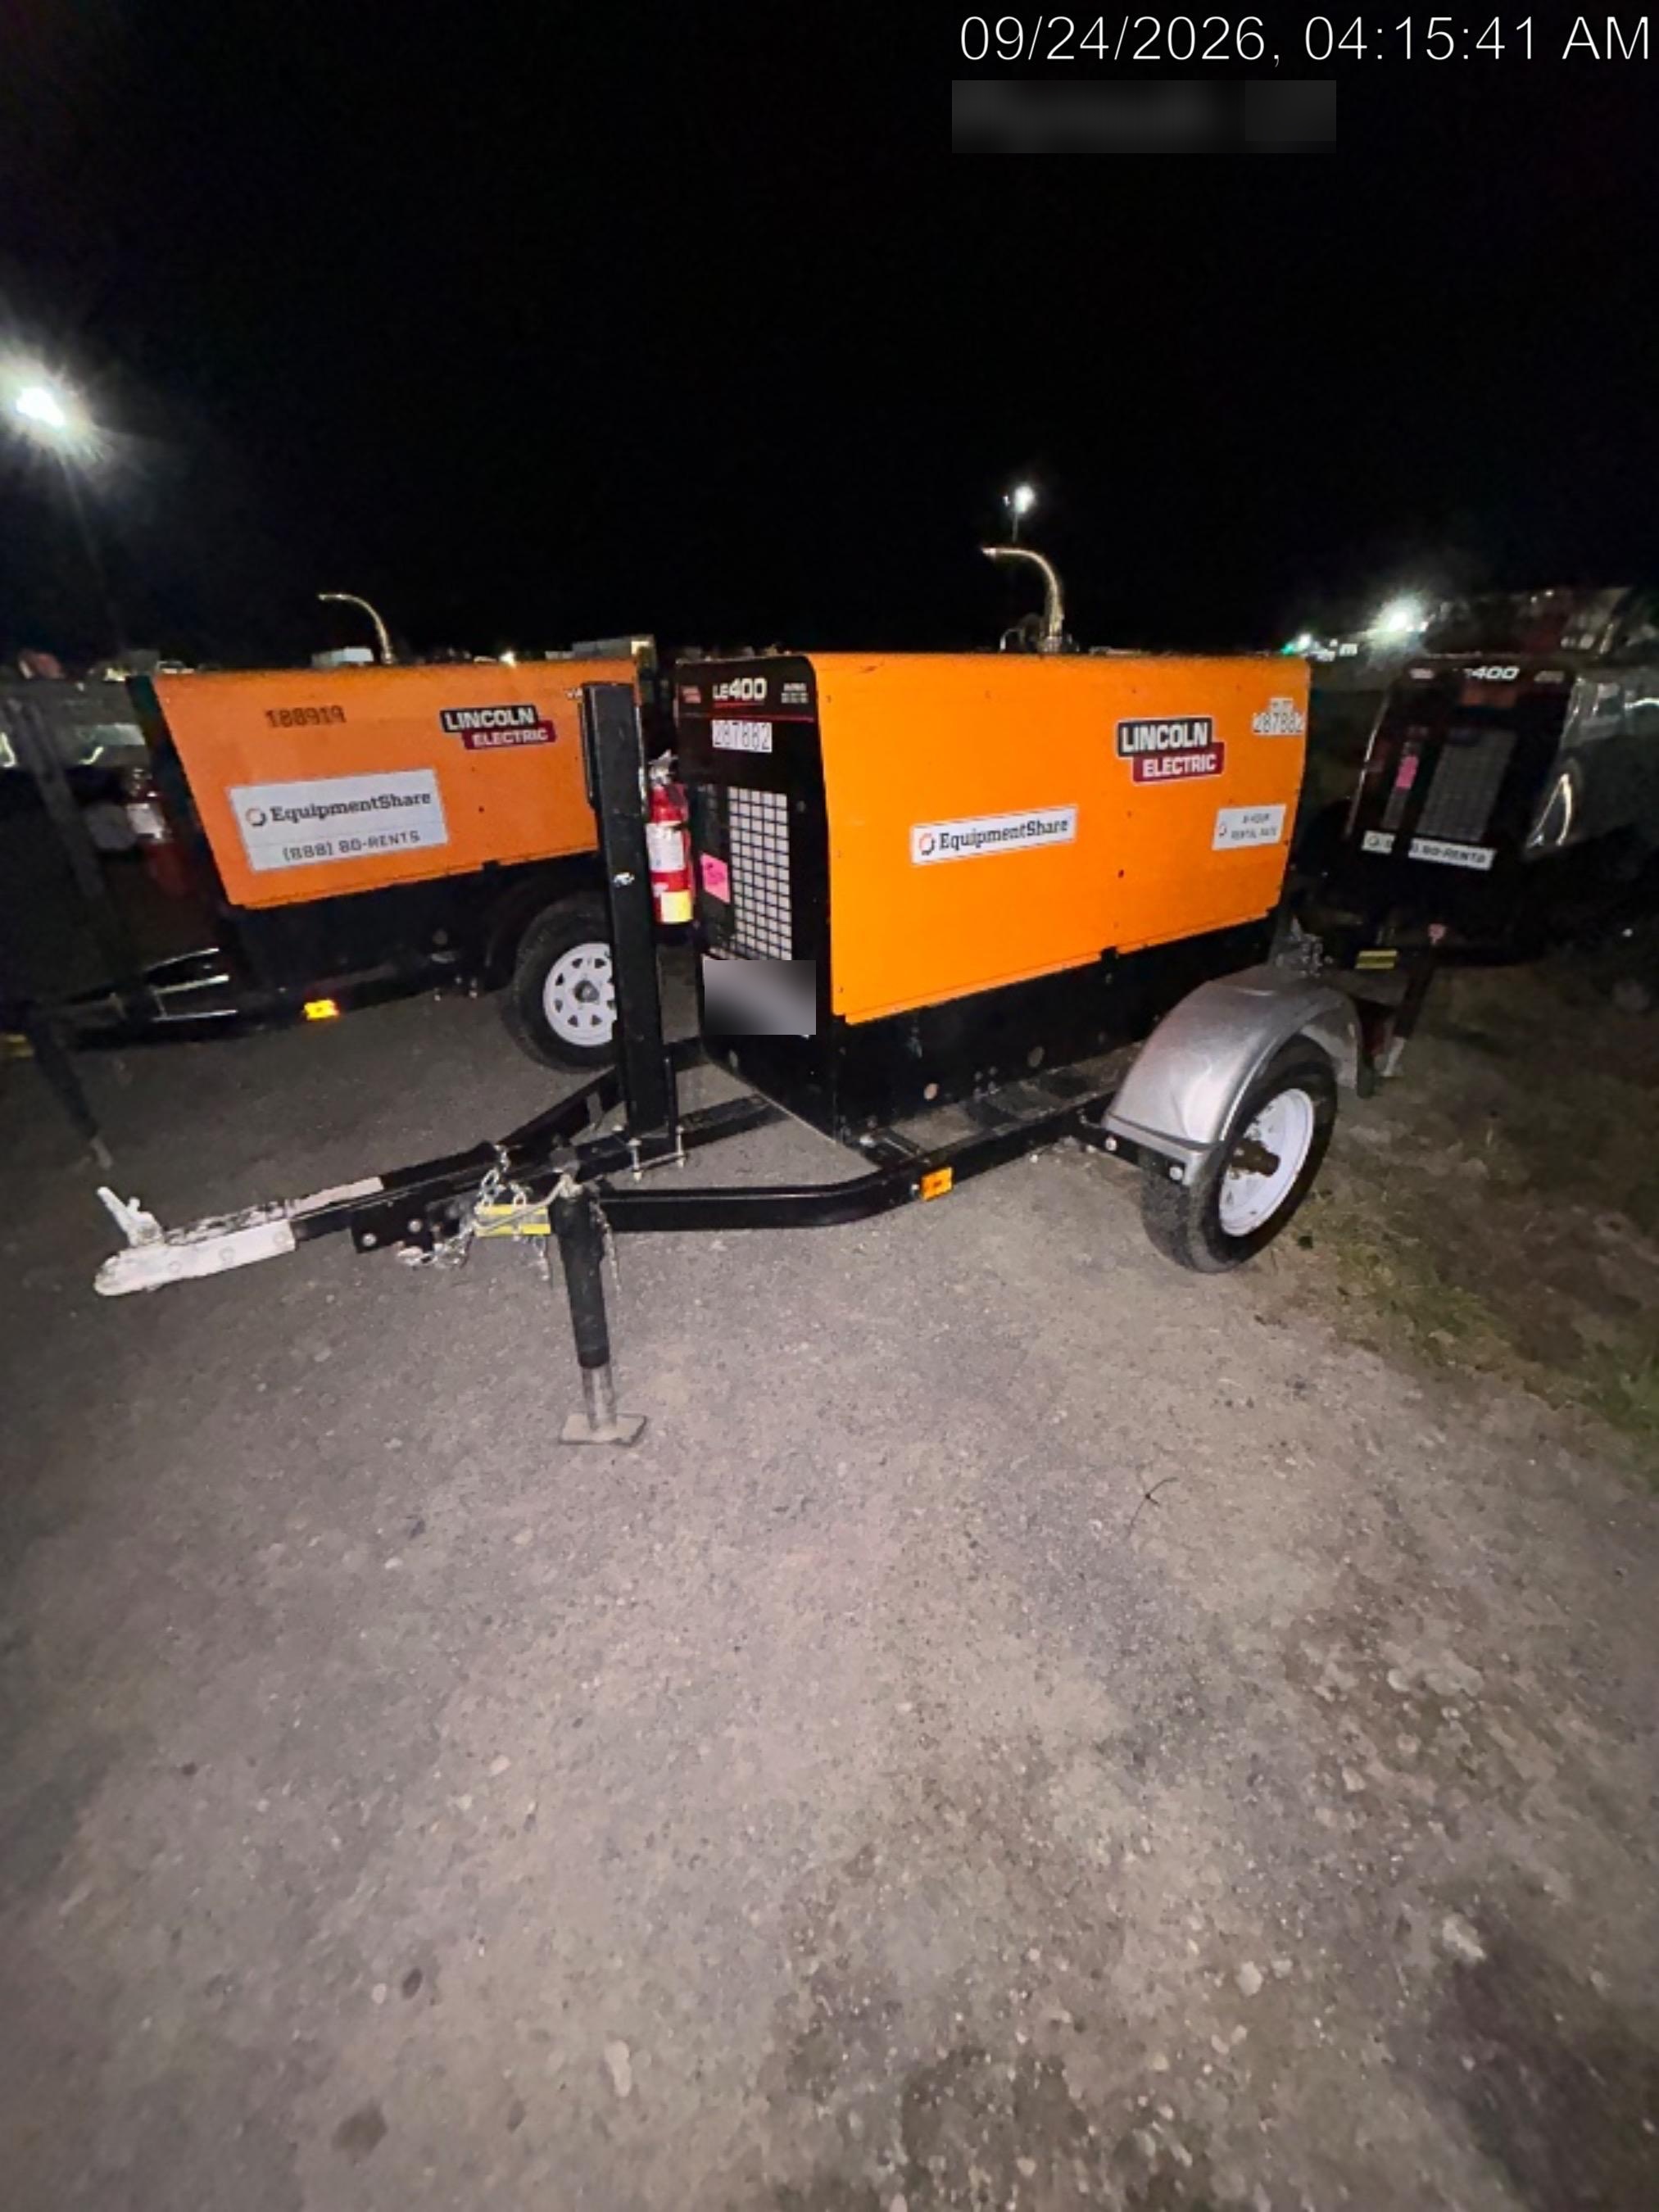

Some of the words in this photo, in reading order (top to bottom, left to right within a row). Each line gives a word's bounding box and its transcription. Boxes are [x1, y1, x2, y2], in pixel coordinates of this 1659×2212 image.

[1464, 664, 1521, 681] 400
[712, 677, 768, 701] LE400
[444, 706, 535, 732] LINCOLN
[471, 727, 550, 748] ELECTRIC
[1121, 721, 1209, 754] LINCOLN
[1141, 752, 1218, 778] ELECTRIC
[268, 791, 433, 824] EquipmentShare
[937, 818, 1068, 852] EquipmentShare
